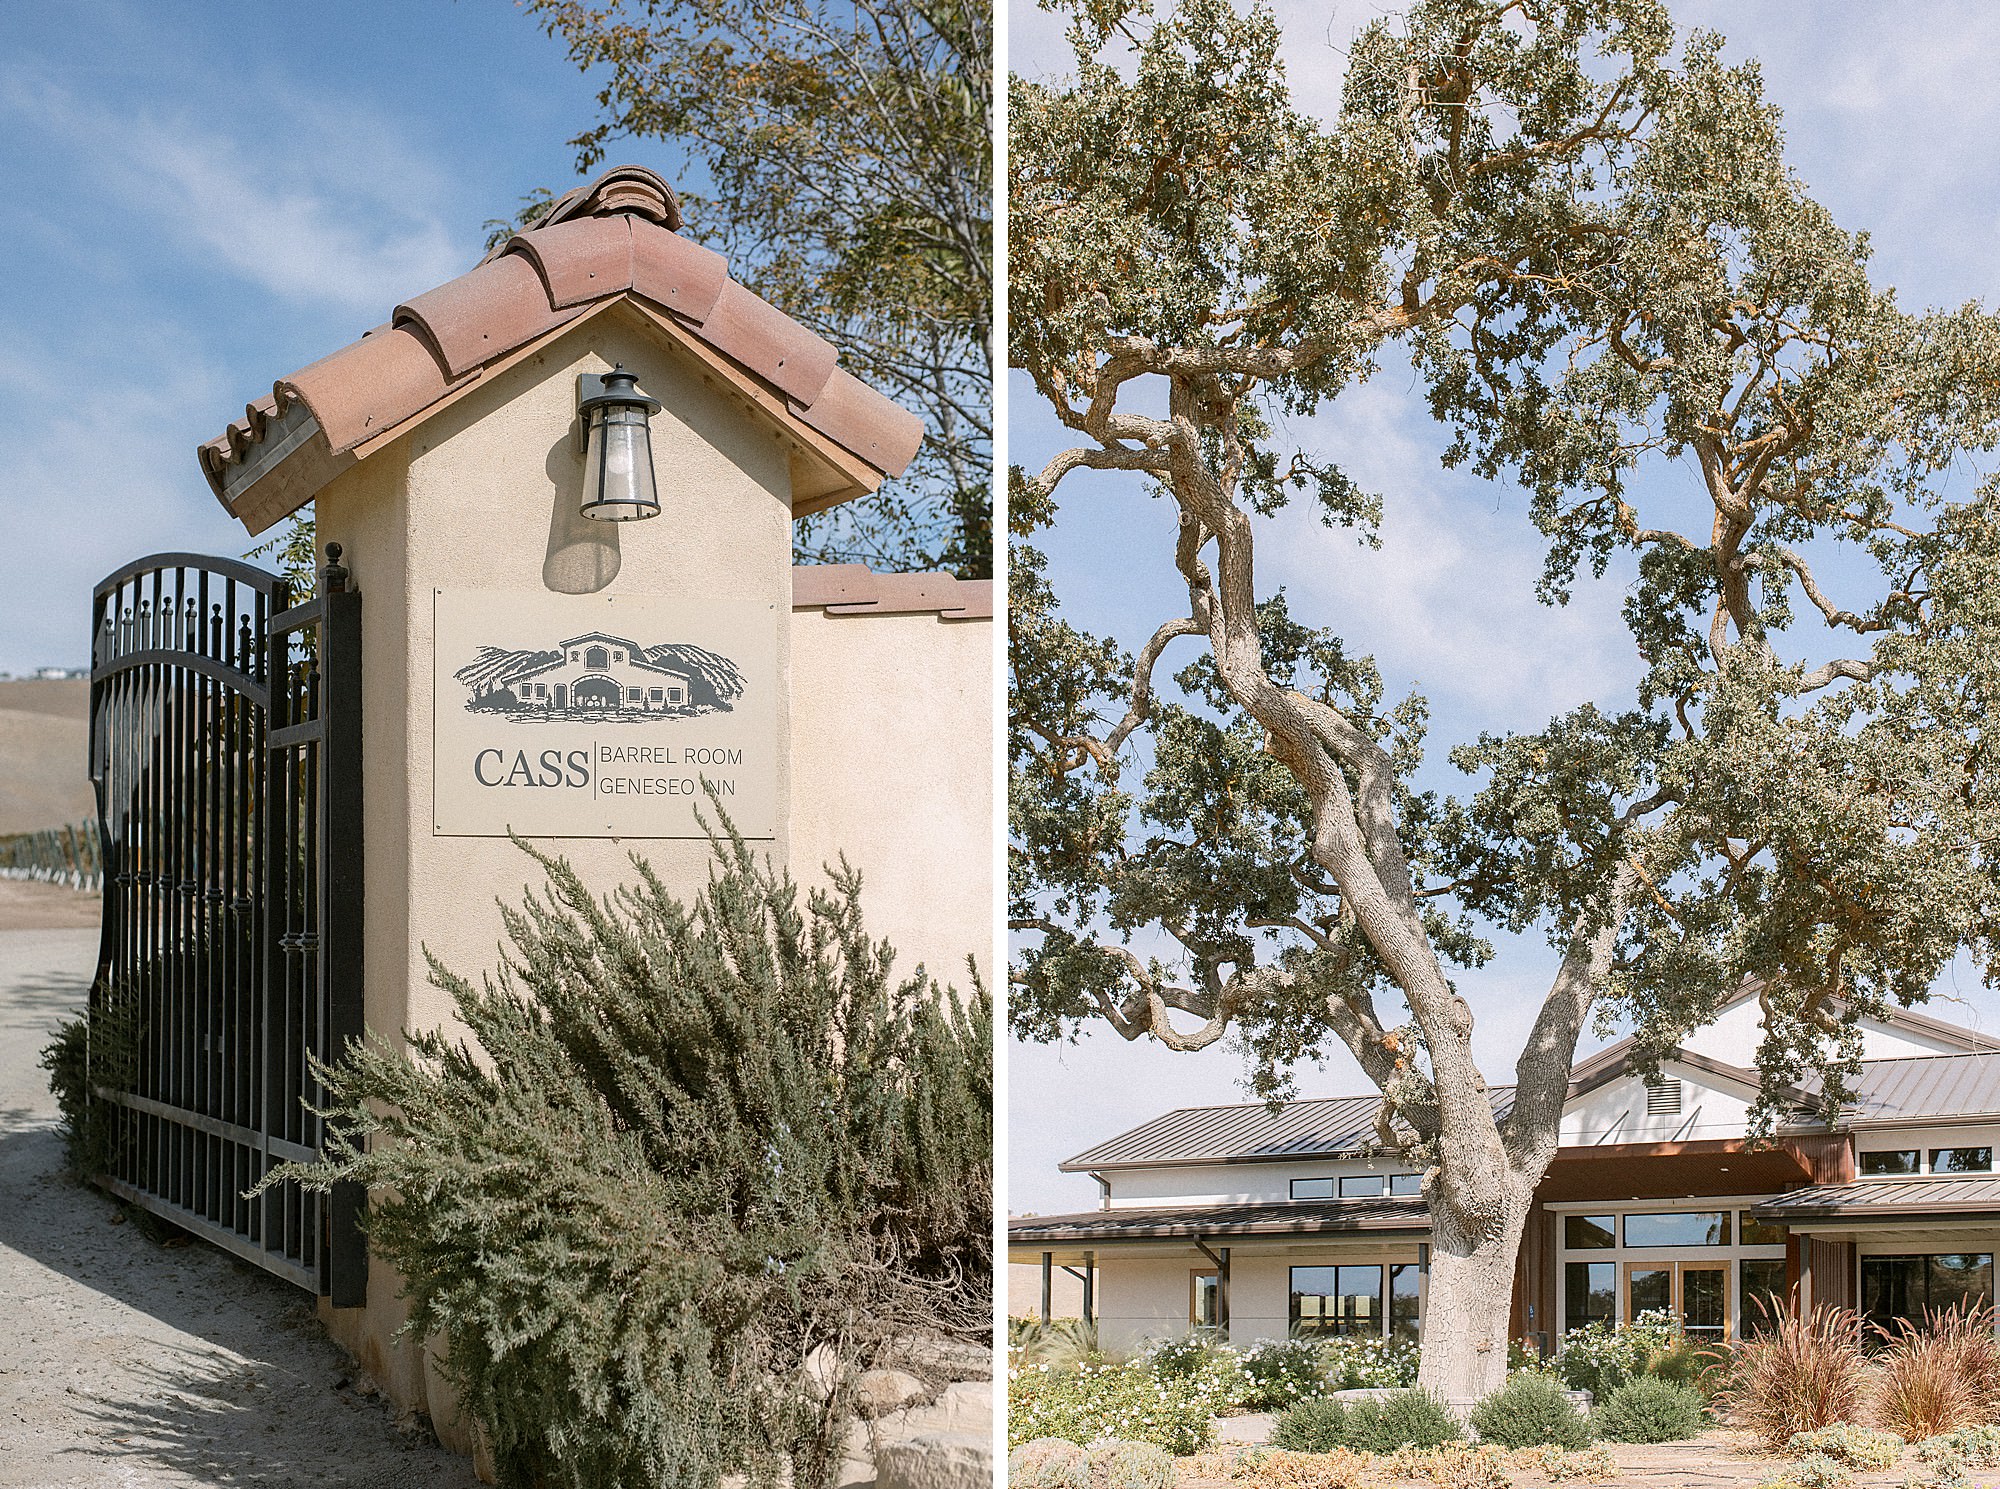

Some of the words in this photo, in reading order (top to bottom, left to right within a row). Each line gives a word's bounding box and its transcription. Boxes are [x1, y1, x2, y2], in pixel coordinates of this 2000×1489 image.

[600, 746, 677, 764] BARREL
[684, 747, 742, 765] ROOM
[474, 748, 590, 788] CASS
[600, 777, 695, 795] GENESEO
